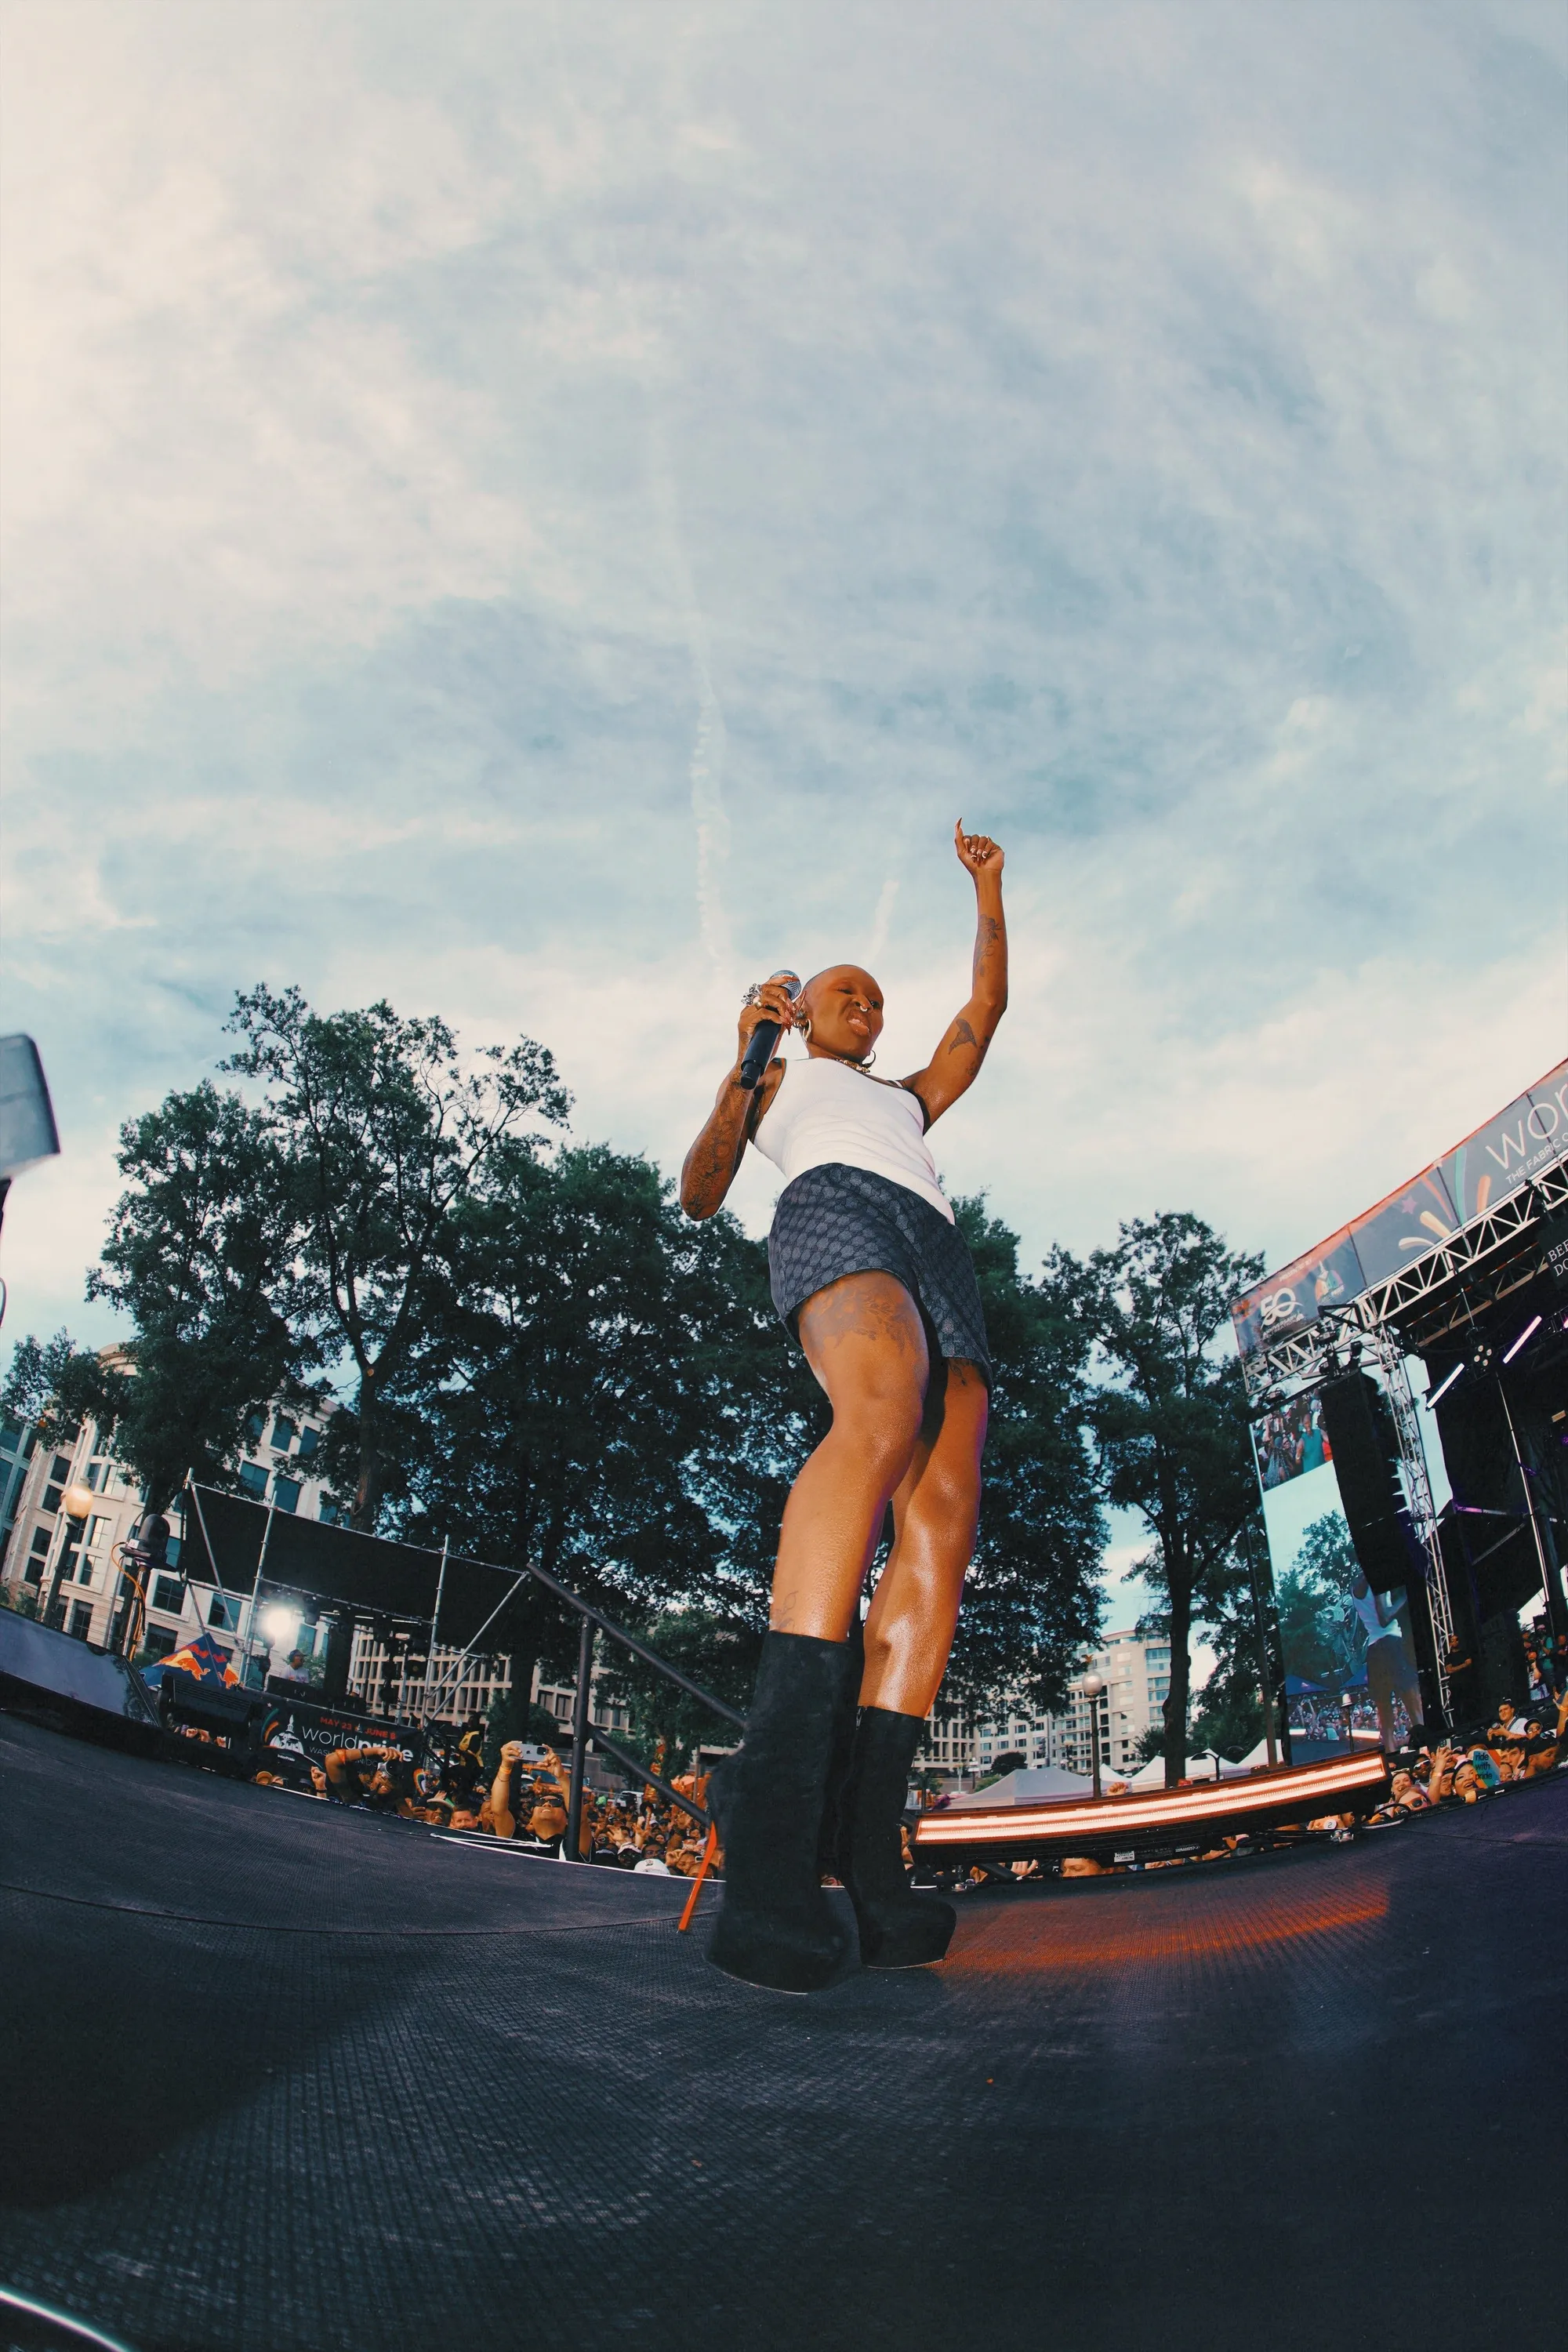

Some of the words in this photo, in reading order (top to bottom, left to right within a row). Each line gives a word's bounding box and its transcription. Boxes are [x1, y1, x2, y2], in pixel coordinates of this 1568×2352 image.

[1505, 1166, 1526, 1185] THE
[1526, 1138, 1562, 1171] FABRIC
[1260, 1287, 1297, 1327] 50
[320, 1716, 339, 1726] MAY
[341, 1722, 352, 1731] 23
[365, 1727, 389, 1738] JUNE
[1475, 1752, 1490, 1761] ride
[1475, 1761, 1491, 1770] with
